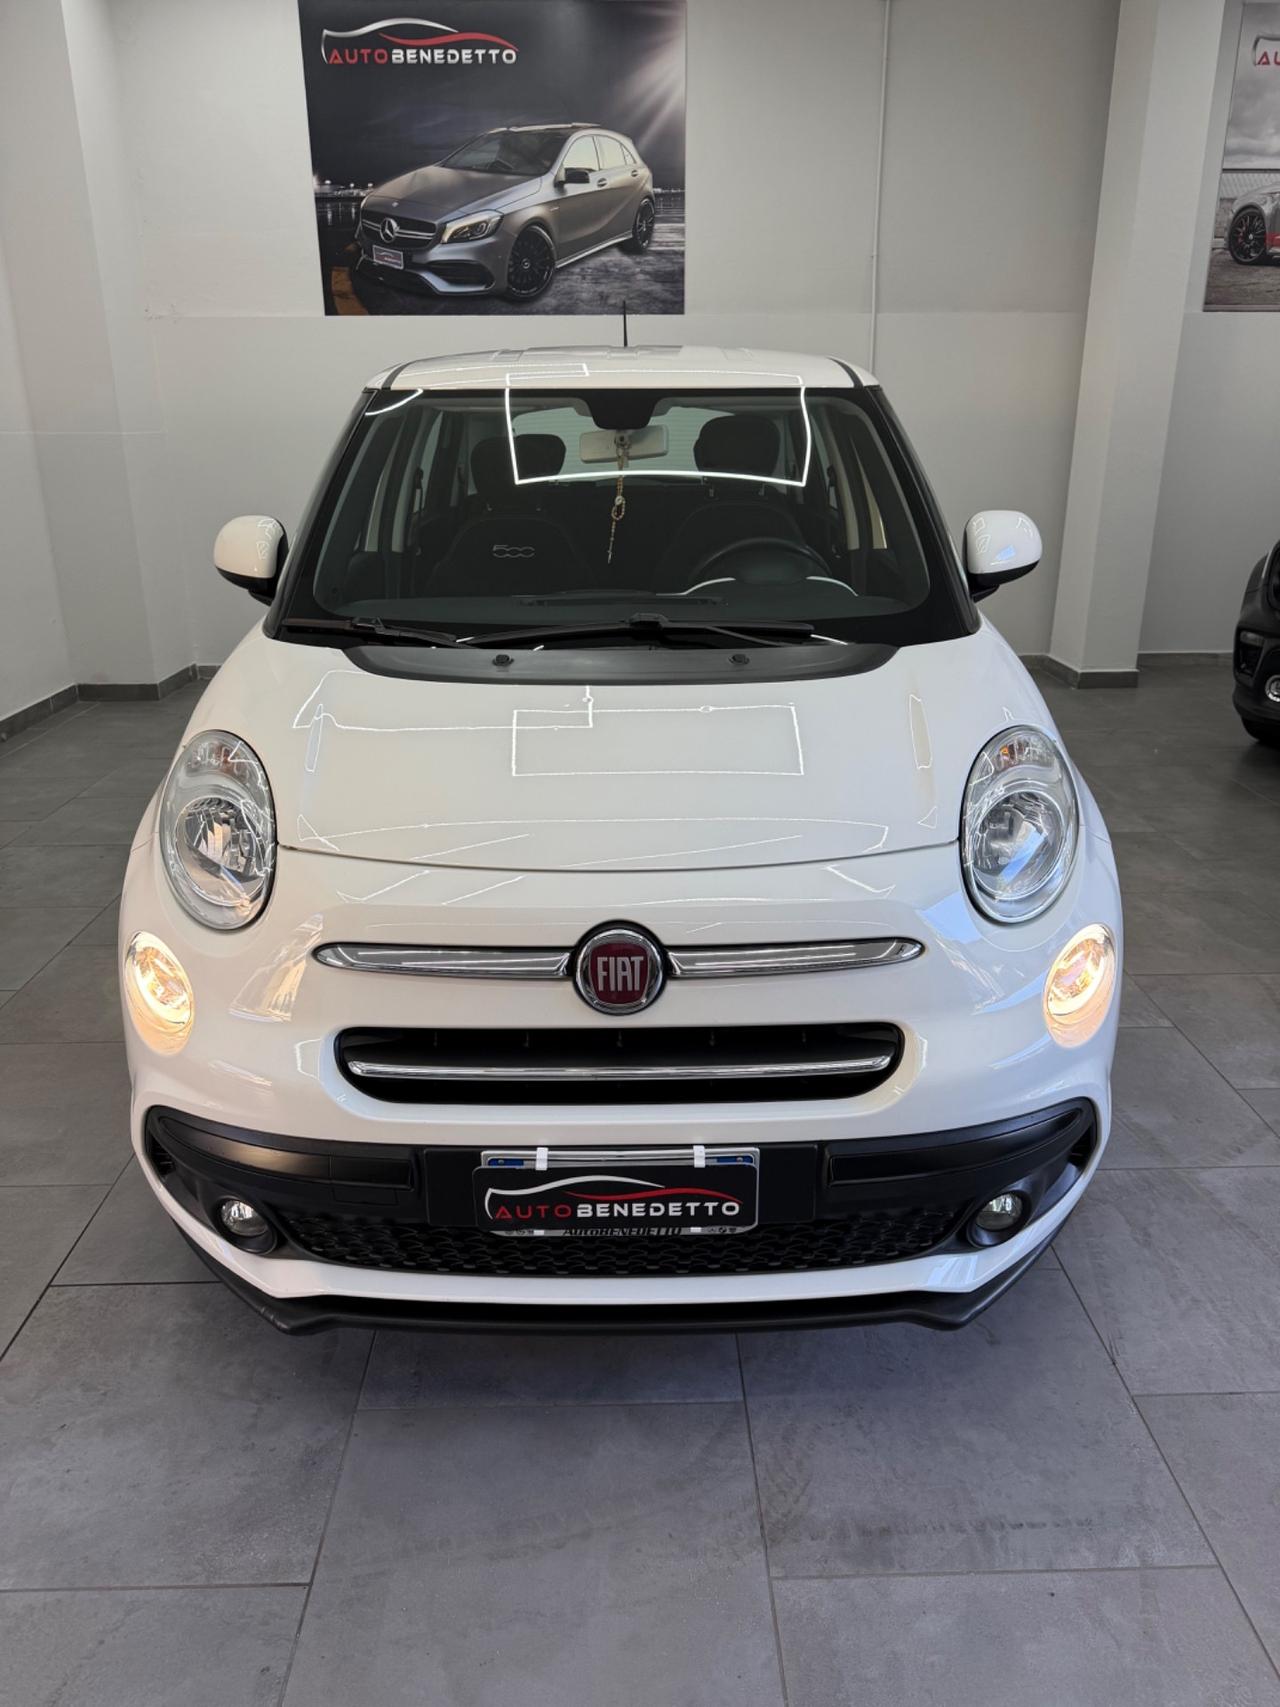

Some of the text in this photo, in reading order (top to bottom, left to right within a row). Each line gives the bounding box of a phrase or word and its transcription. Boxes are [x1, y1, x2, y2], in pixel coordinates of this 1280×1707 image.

[328, 49, 516, 64] AUTOBENEDETTO
[493, 544, 535, 558] 500
[597, 956, 644, 991] FIAT
[495, 1202, 740, 1220] AUTOBENEDETTO
